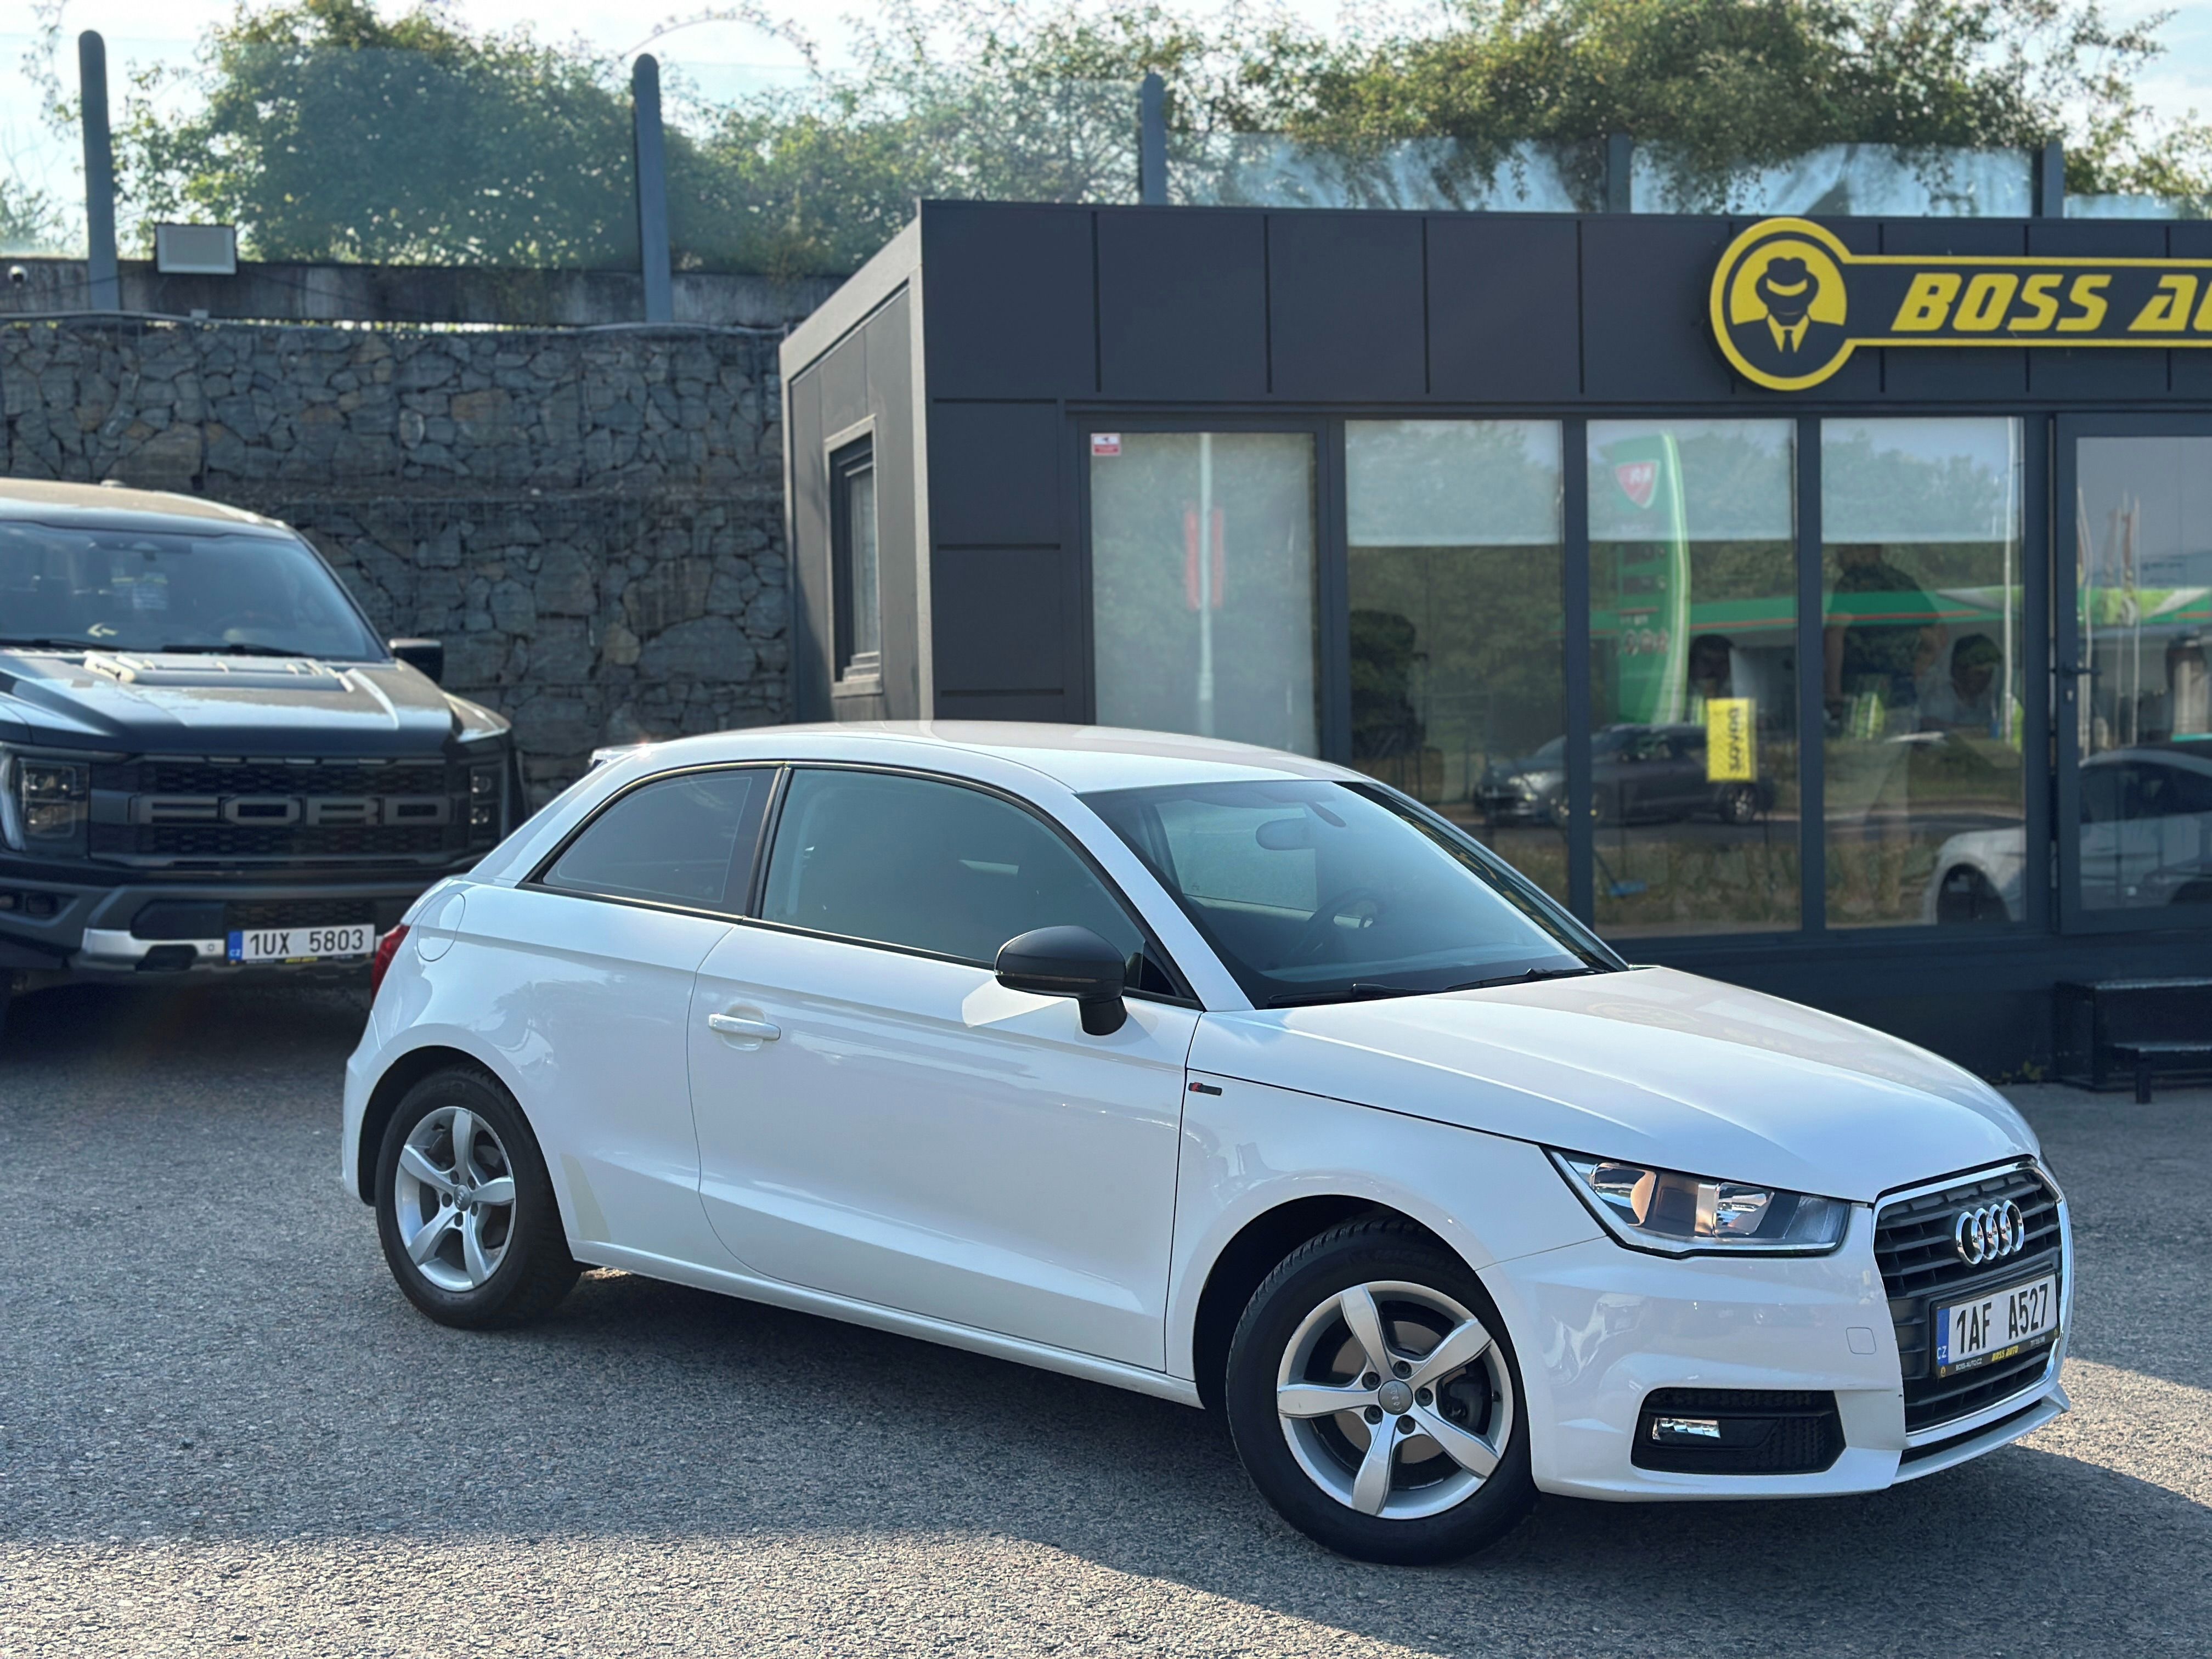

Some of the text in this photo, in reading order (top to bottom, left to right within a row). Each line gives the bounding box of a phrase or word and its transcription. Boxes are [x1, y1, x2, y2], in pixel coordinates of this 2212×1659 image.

[1891, 273, 2112, 331] BOSS
[137, 793, 451, 825] FORD
[229, 949, 241, 957] CZ
[250, 928, 363, 956] 1UX 5803
[1956, 1283, 2048, 1355] 1AF A527
[1937, 1345, 1948, 1359] CZ
